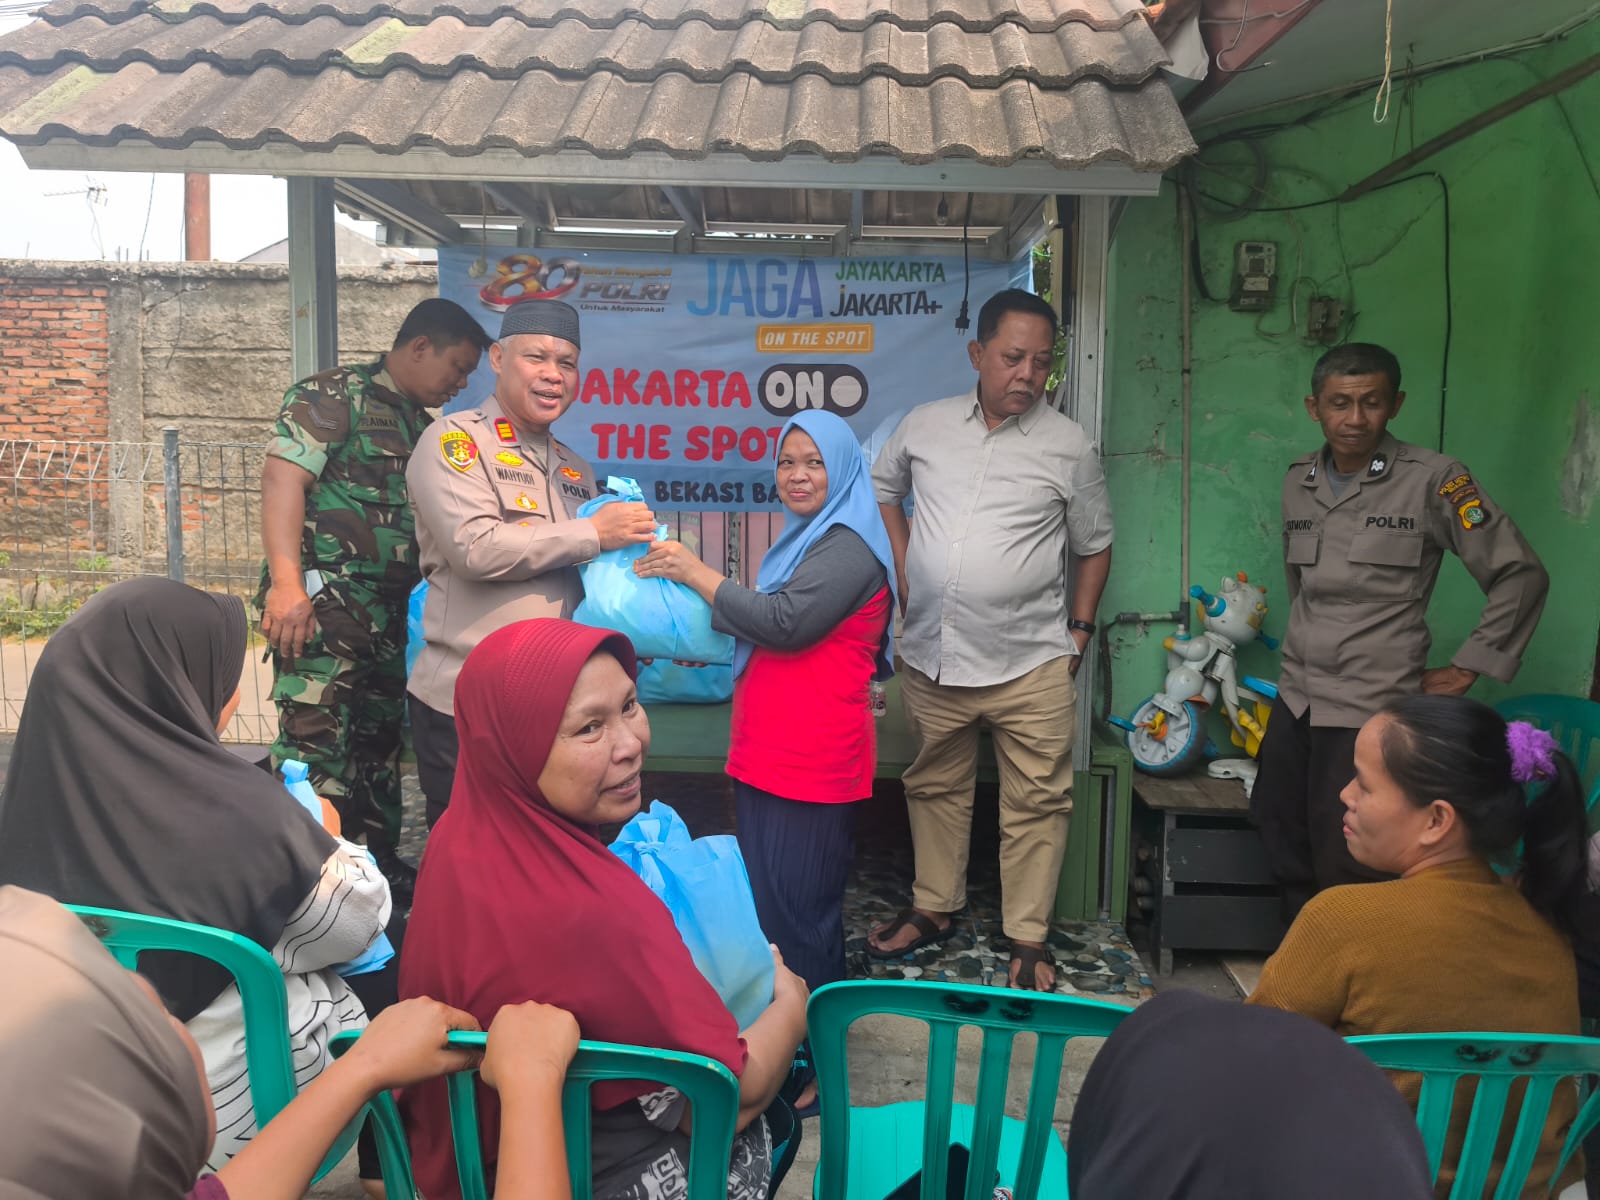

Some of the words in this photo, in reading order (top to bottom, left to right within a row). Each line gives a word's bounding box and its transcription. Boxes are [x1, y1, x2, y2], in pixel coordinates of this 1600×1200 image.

[835, 261, 946, 282] JAYAKARTA
[579, 281, 673, 300] POLRI
[687, 257, 823, 318] JAGA
[764, 332, 784, 346] ON
[792, 331, 820, 346] THE
[825, 331, 866, 346] SPOT
[764, 370, 824, 409] ON
[590, 423, 672, 460] THE
[562, 483, 591, 501] POLRI
[655, 481, 745, 503] BEKASI
[1365, 516, 1415, 530] POLRI
